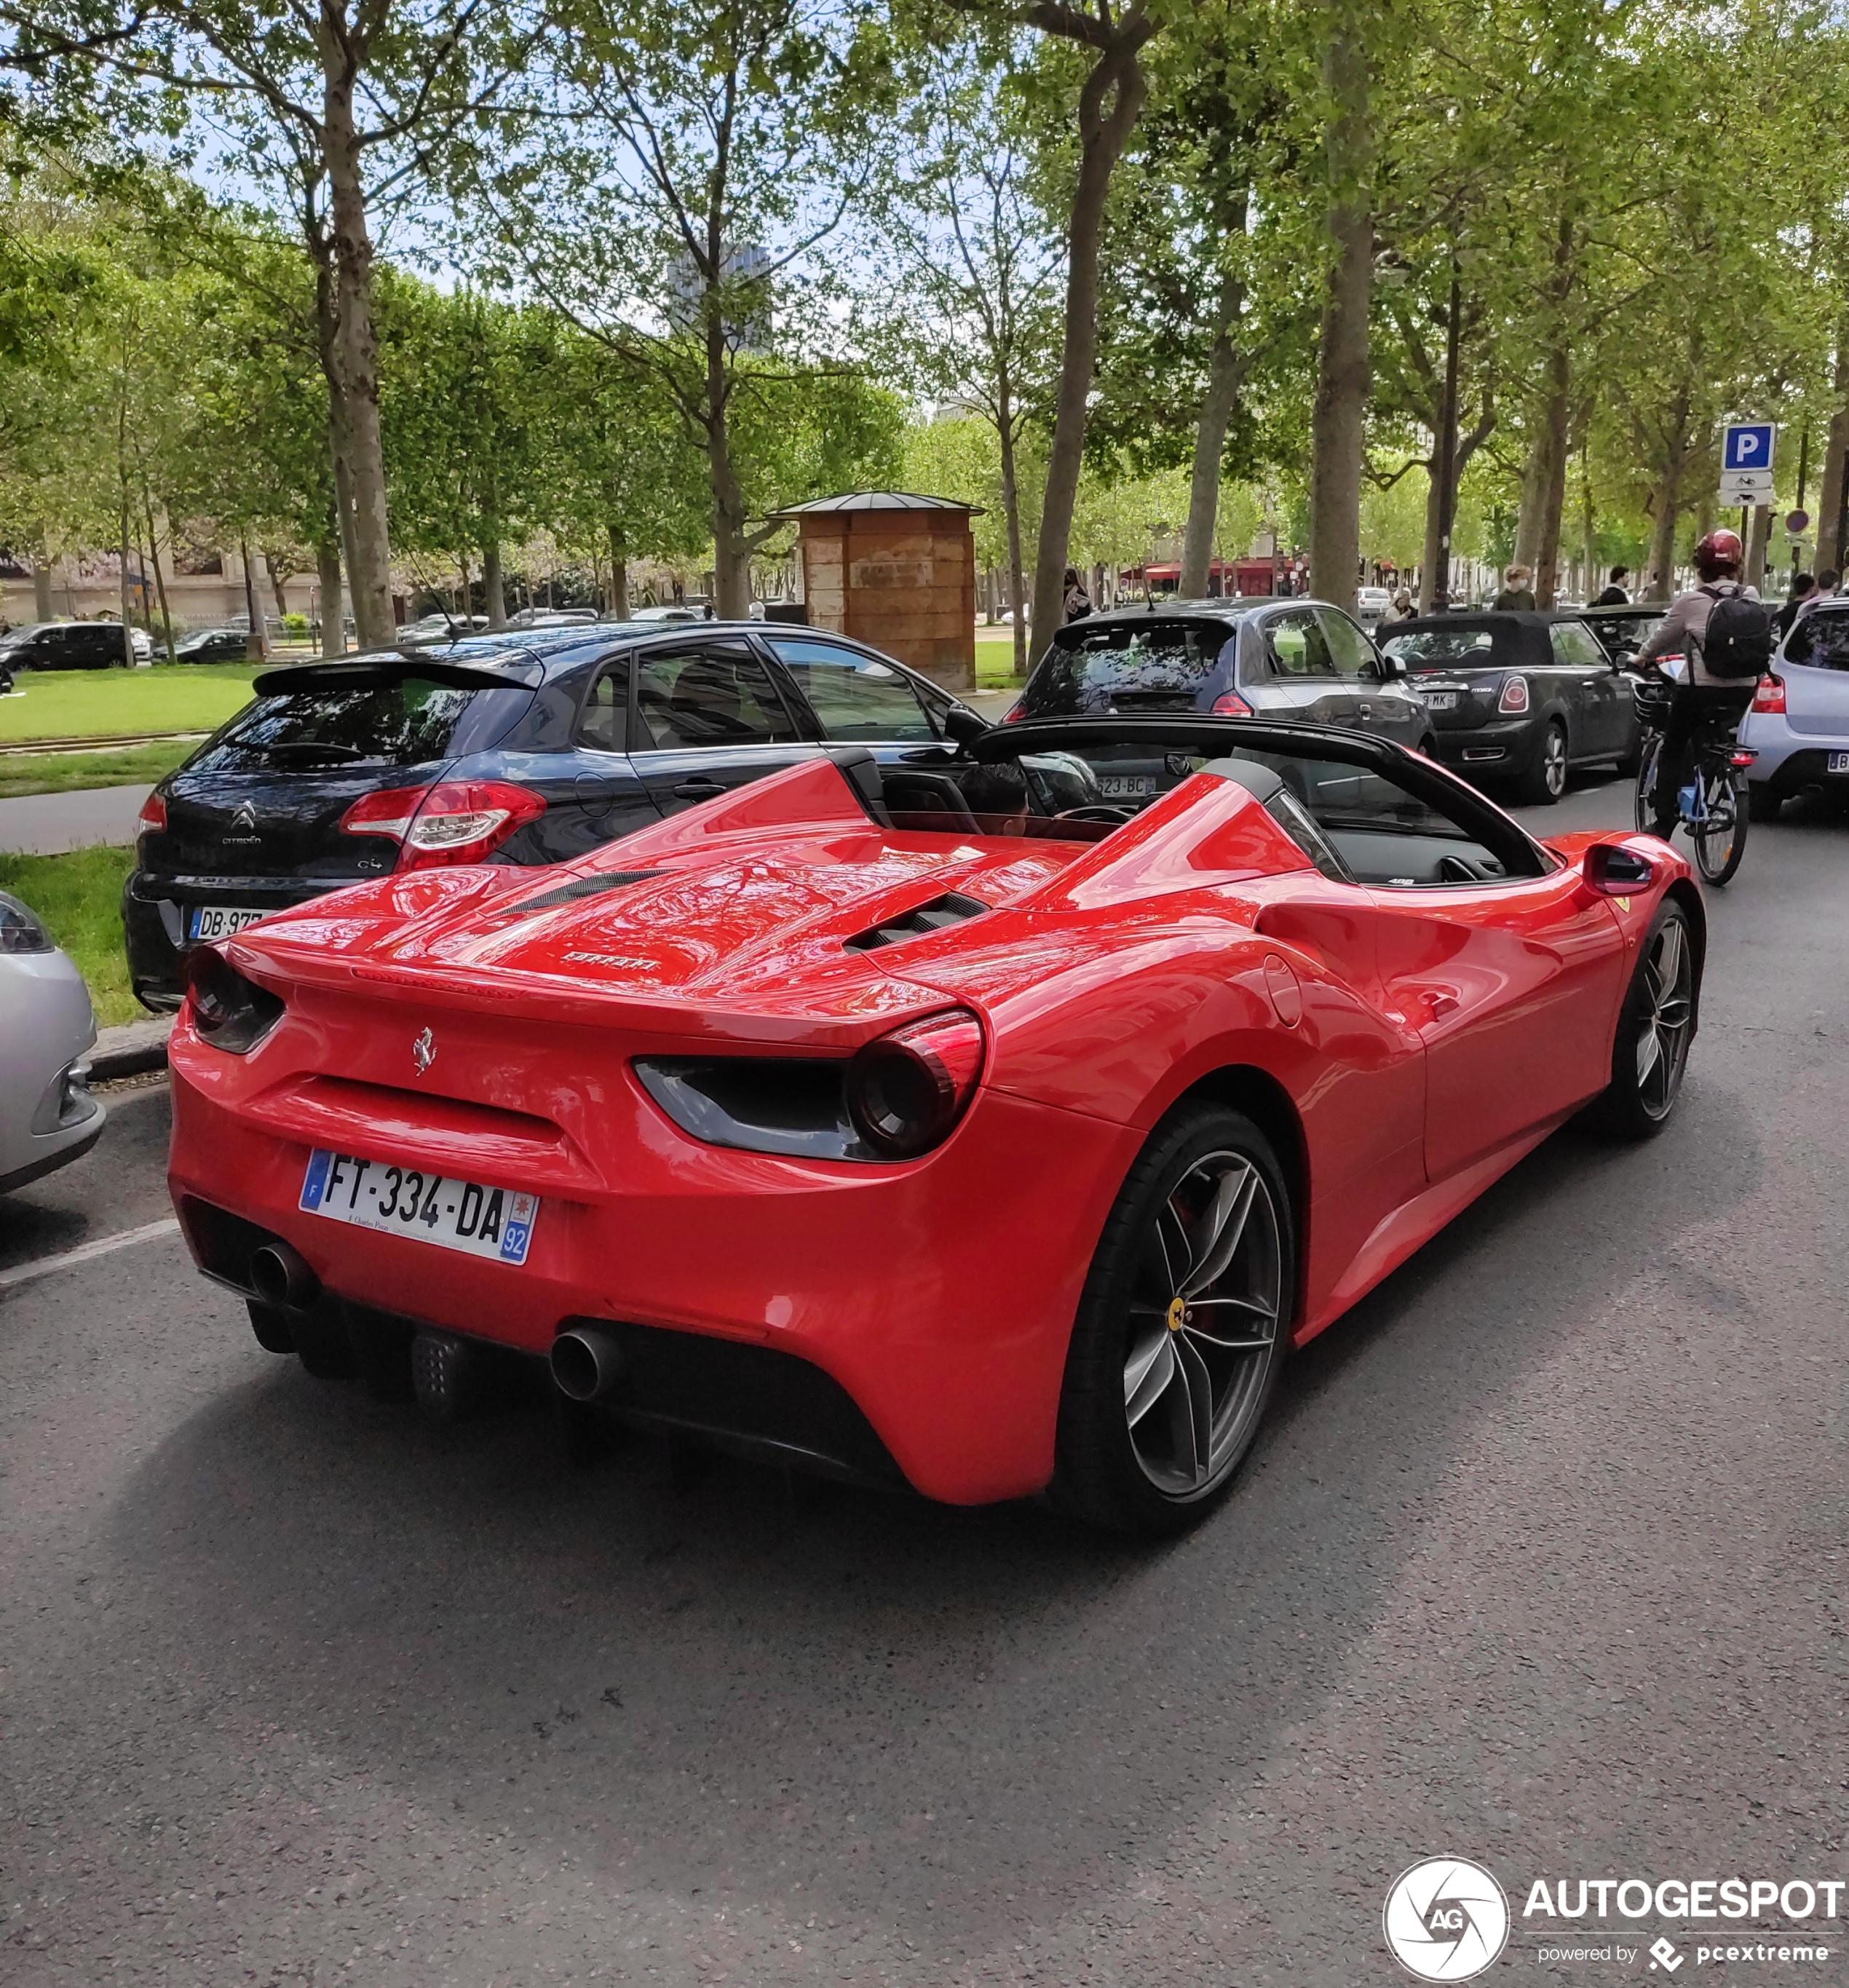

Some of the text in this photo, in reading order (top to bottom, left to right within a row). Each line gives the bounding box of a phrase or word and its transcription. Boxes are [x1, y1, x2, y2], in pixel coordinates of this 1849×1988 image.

[1736, 434, 1759, 462] P
[357, 858, 383, 868] C4
[309, 1184, 317, 1197] F
[325, 1154, 504, 1244] FT-334-DA
[504, 1227, 526, 1254] 92
